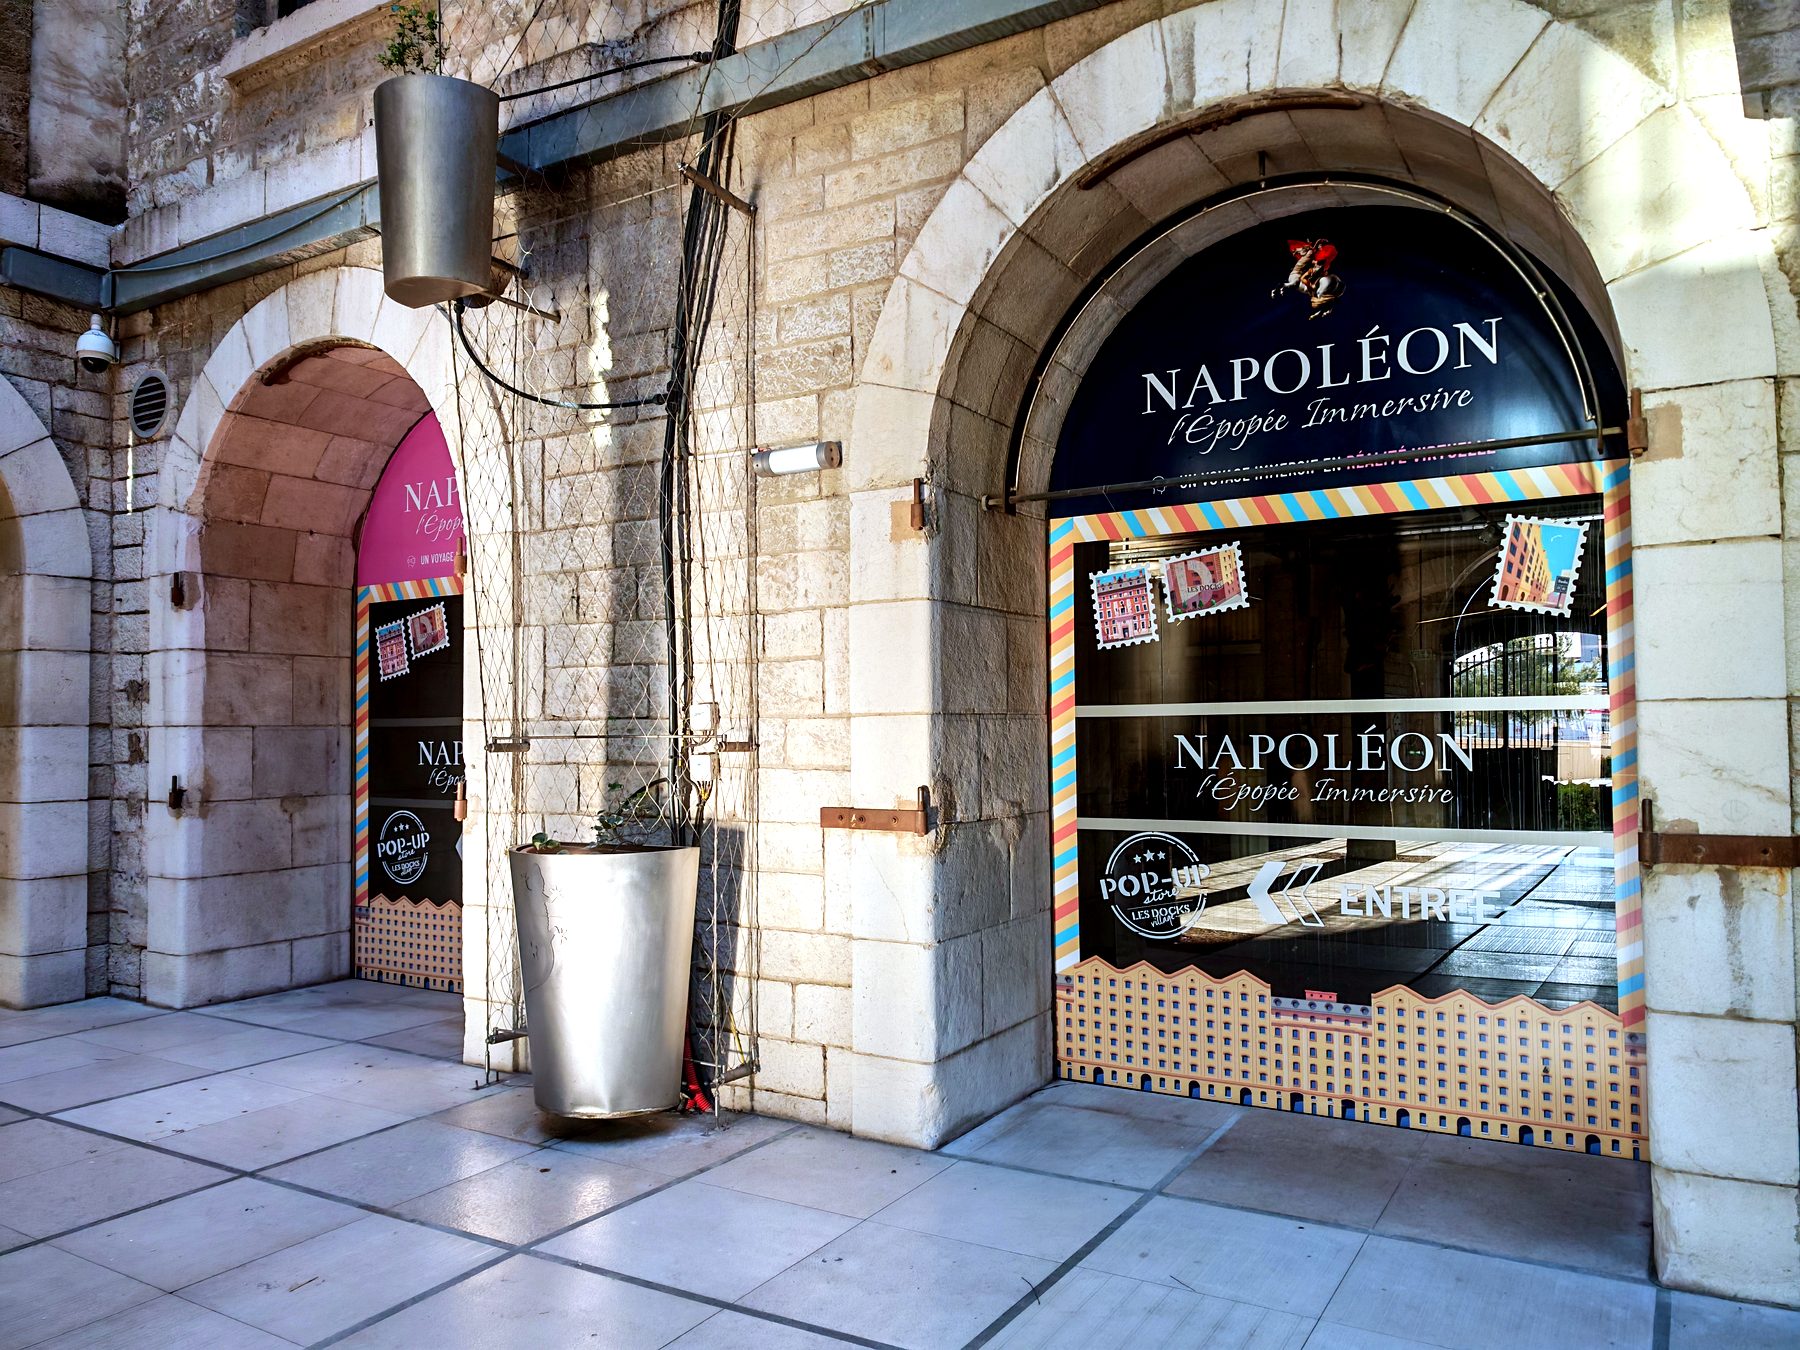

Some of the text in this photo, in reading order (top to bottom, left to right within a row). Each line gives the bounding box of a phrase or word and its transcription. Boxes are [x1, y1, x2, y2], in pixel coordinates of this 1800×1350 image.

[1142, 317, 1503, 414] NAPOLÉON
[1168, 387, 1474, 454] l'Épopée Immersive
[420, 554, 429, 565] UN
[1173, 724, 1478, 772] NAPOLÉON
[1196, 771, 1454, 812] l'Épopée Immersive
[377, 832, 430, 858] POP-UP
[1099, 863, 1211, 900] POP-UP
[1143, 888, 1179, 904] store
[1131, 904, 1191, 921] LES DOCKS
